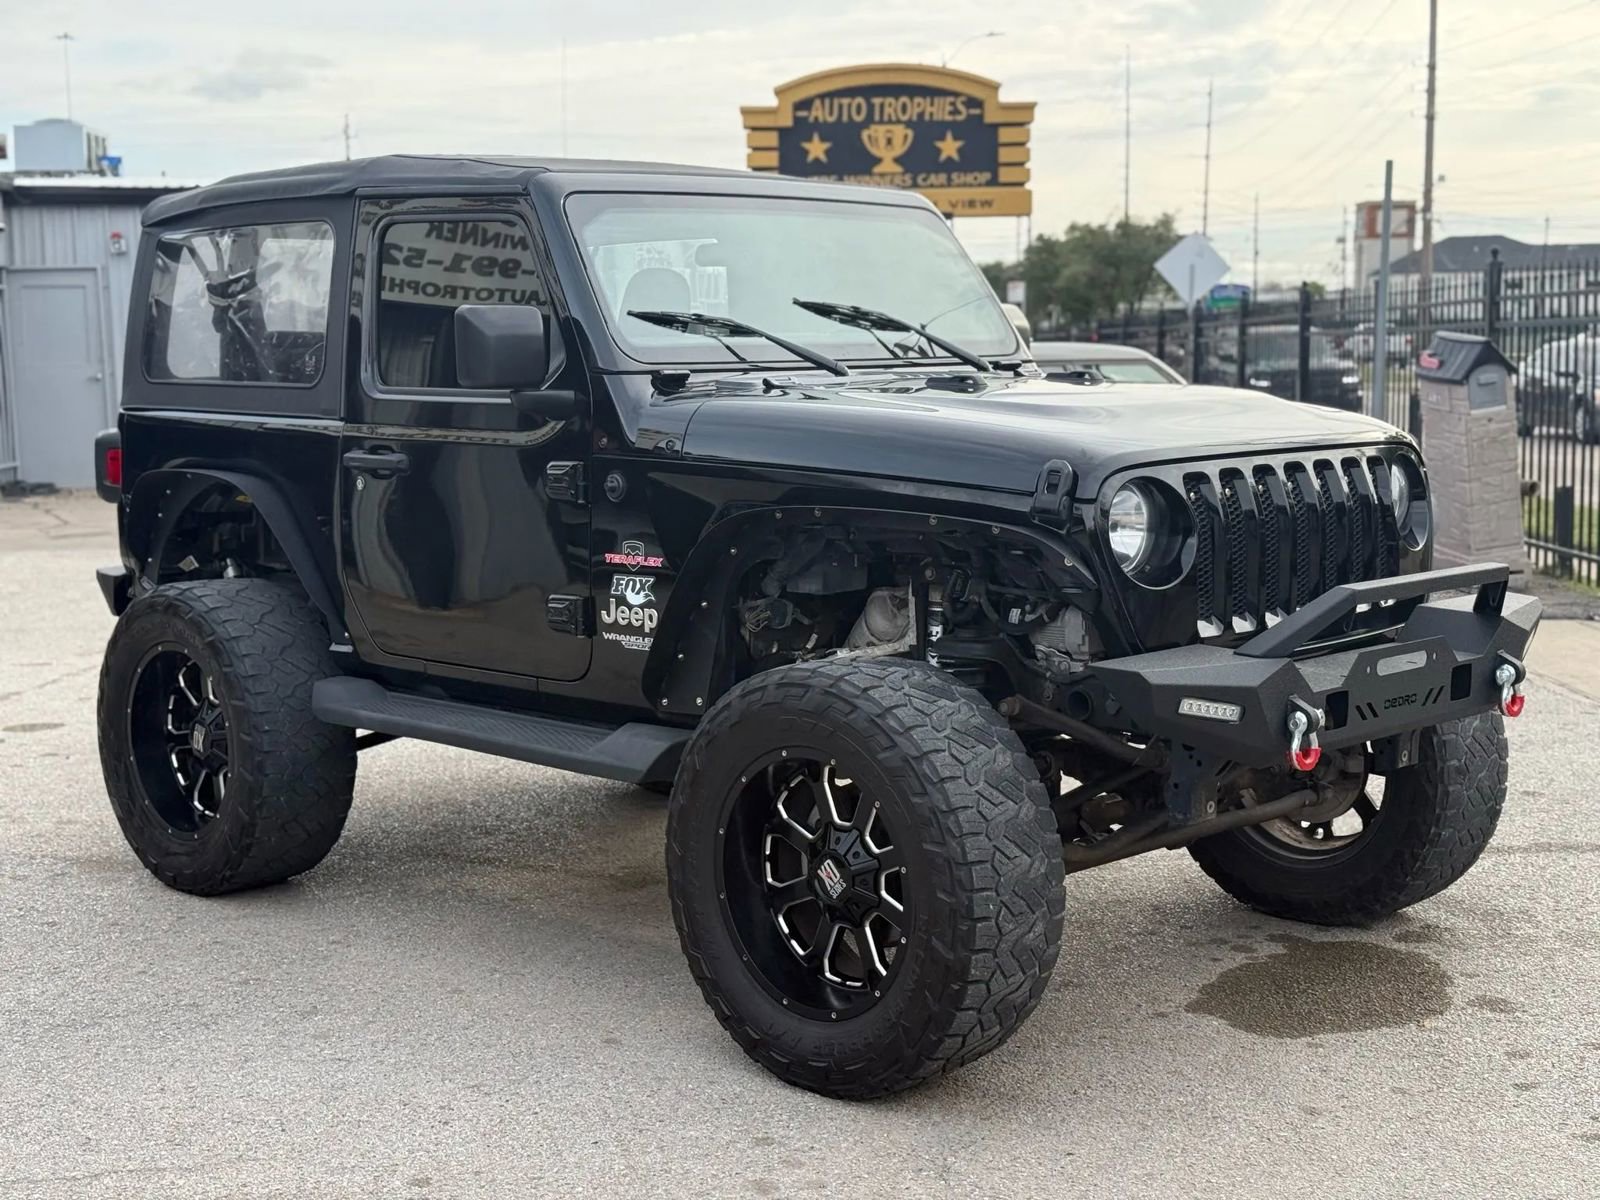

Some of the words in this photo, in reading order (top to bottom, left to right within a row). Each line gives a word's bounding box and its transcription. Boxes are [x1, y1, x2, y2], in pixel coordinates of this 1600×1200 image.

[917, 172, 948, 186] CAR
[951, 171, 991, 185] SHOP
[949, 199, 994, 209] VIEW
[604, 553, 665, 568] TERAFLEX
[611, 575, 655, 597] FOX
[601, 598, 658, 634] Jeep
[602, 631, 654, 645] WRANGLE
[817, 859, 840, 891] XD
